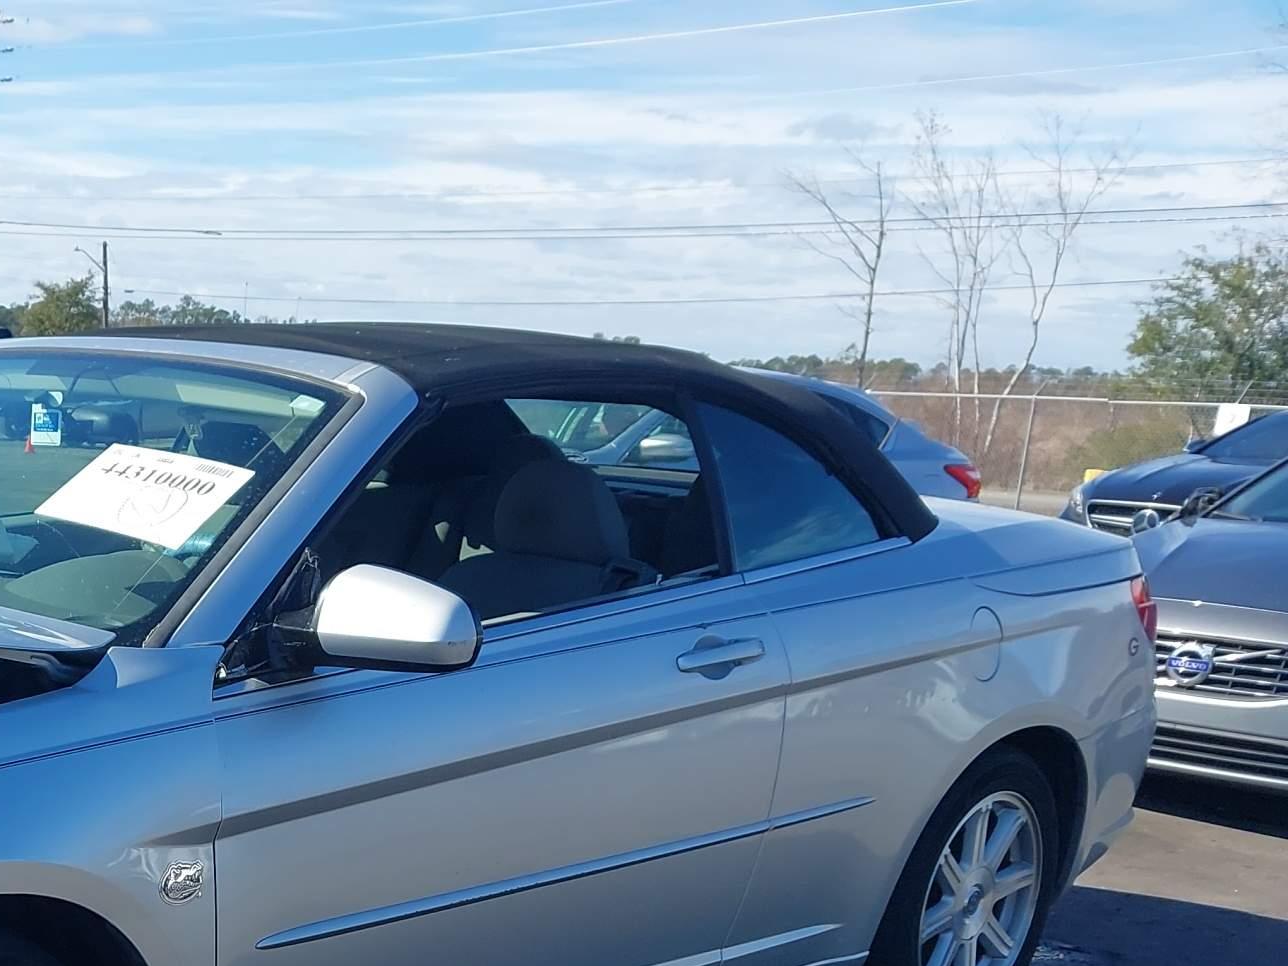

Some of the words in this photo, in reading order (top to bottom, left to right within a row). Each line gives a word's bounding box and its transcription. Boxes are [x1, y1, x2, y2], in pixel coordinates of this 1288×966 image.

[100, 461, 217, 496] 44310000
[1128, 637, 1139, 657] G
[1171, 659, 1207, 671] VOLVO
